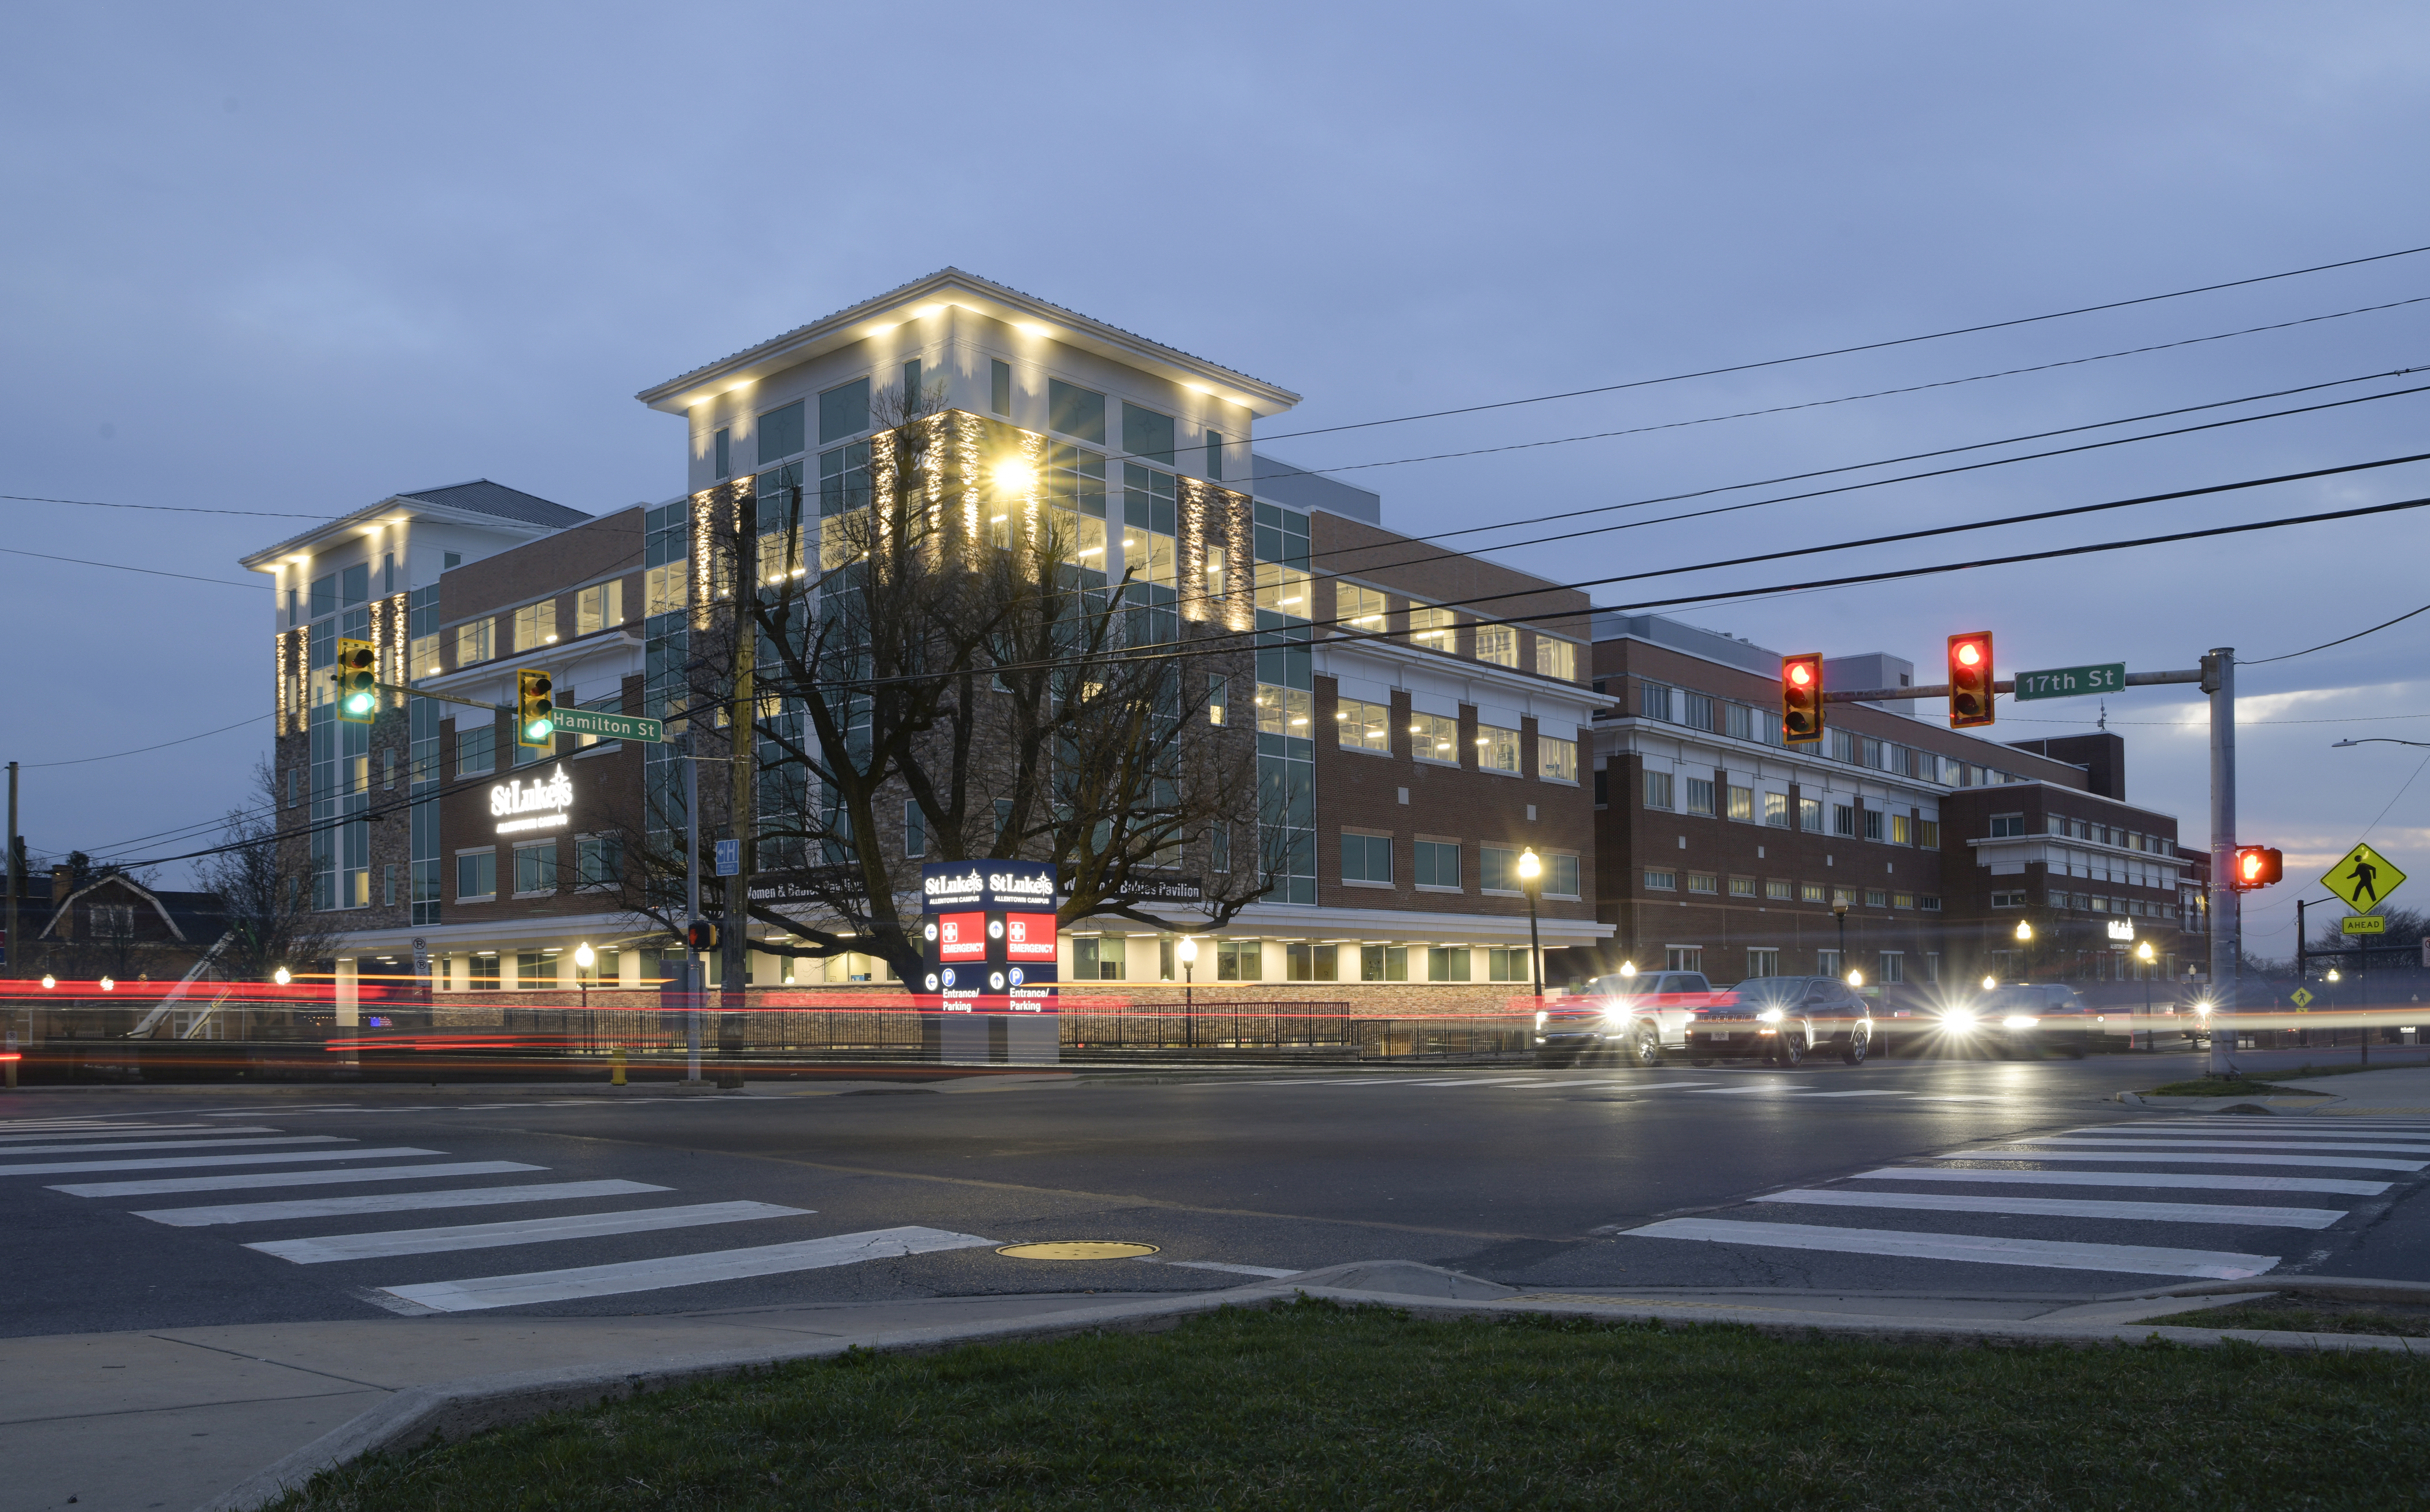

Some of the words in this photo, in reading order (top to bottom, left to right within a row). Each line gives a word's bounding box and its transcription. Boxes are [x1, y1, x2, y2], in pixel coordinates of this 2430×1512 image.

[2026, 673, 2075, 693] 17th
[2089, 670, 2114, 687] St
[554, 712, 630, 734] Hamilton
[638, 722, 654, 737] St
[727, 842, 735, 861] H
[994, 895, 1026, 903] ALLENTOWN
[2347, 921, 2380, 929] AHEAD
[942, 942, 984, 953] EMERGENCY
[1009, 943, 1054, 953] EMERGENCY
[942, 987, 980, 998] Entrance/
[1010, 987, 1050, 998] Entrance/
[942, 1001, 971, 1013] Parking
[1010, 1001, 1041, 1013] Parking
